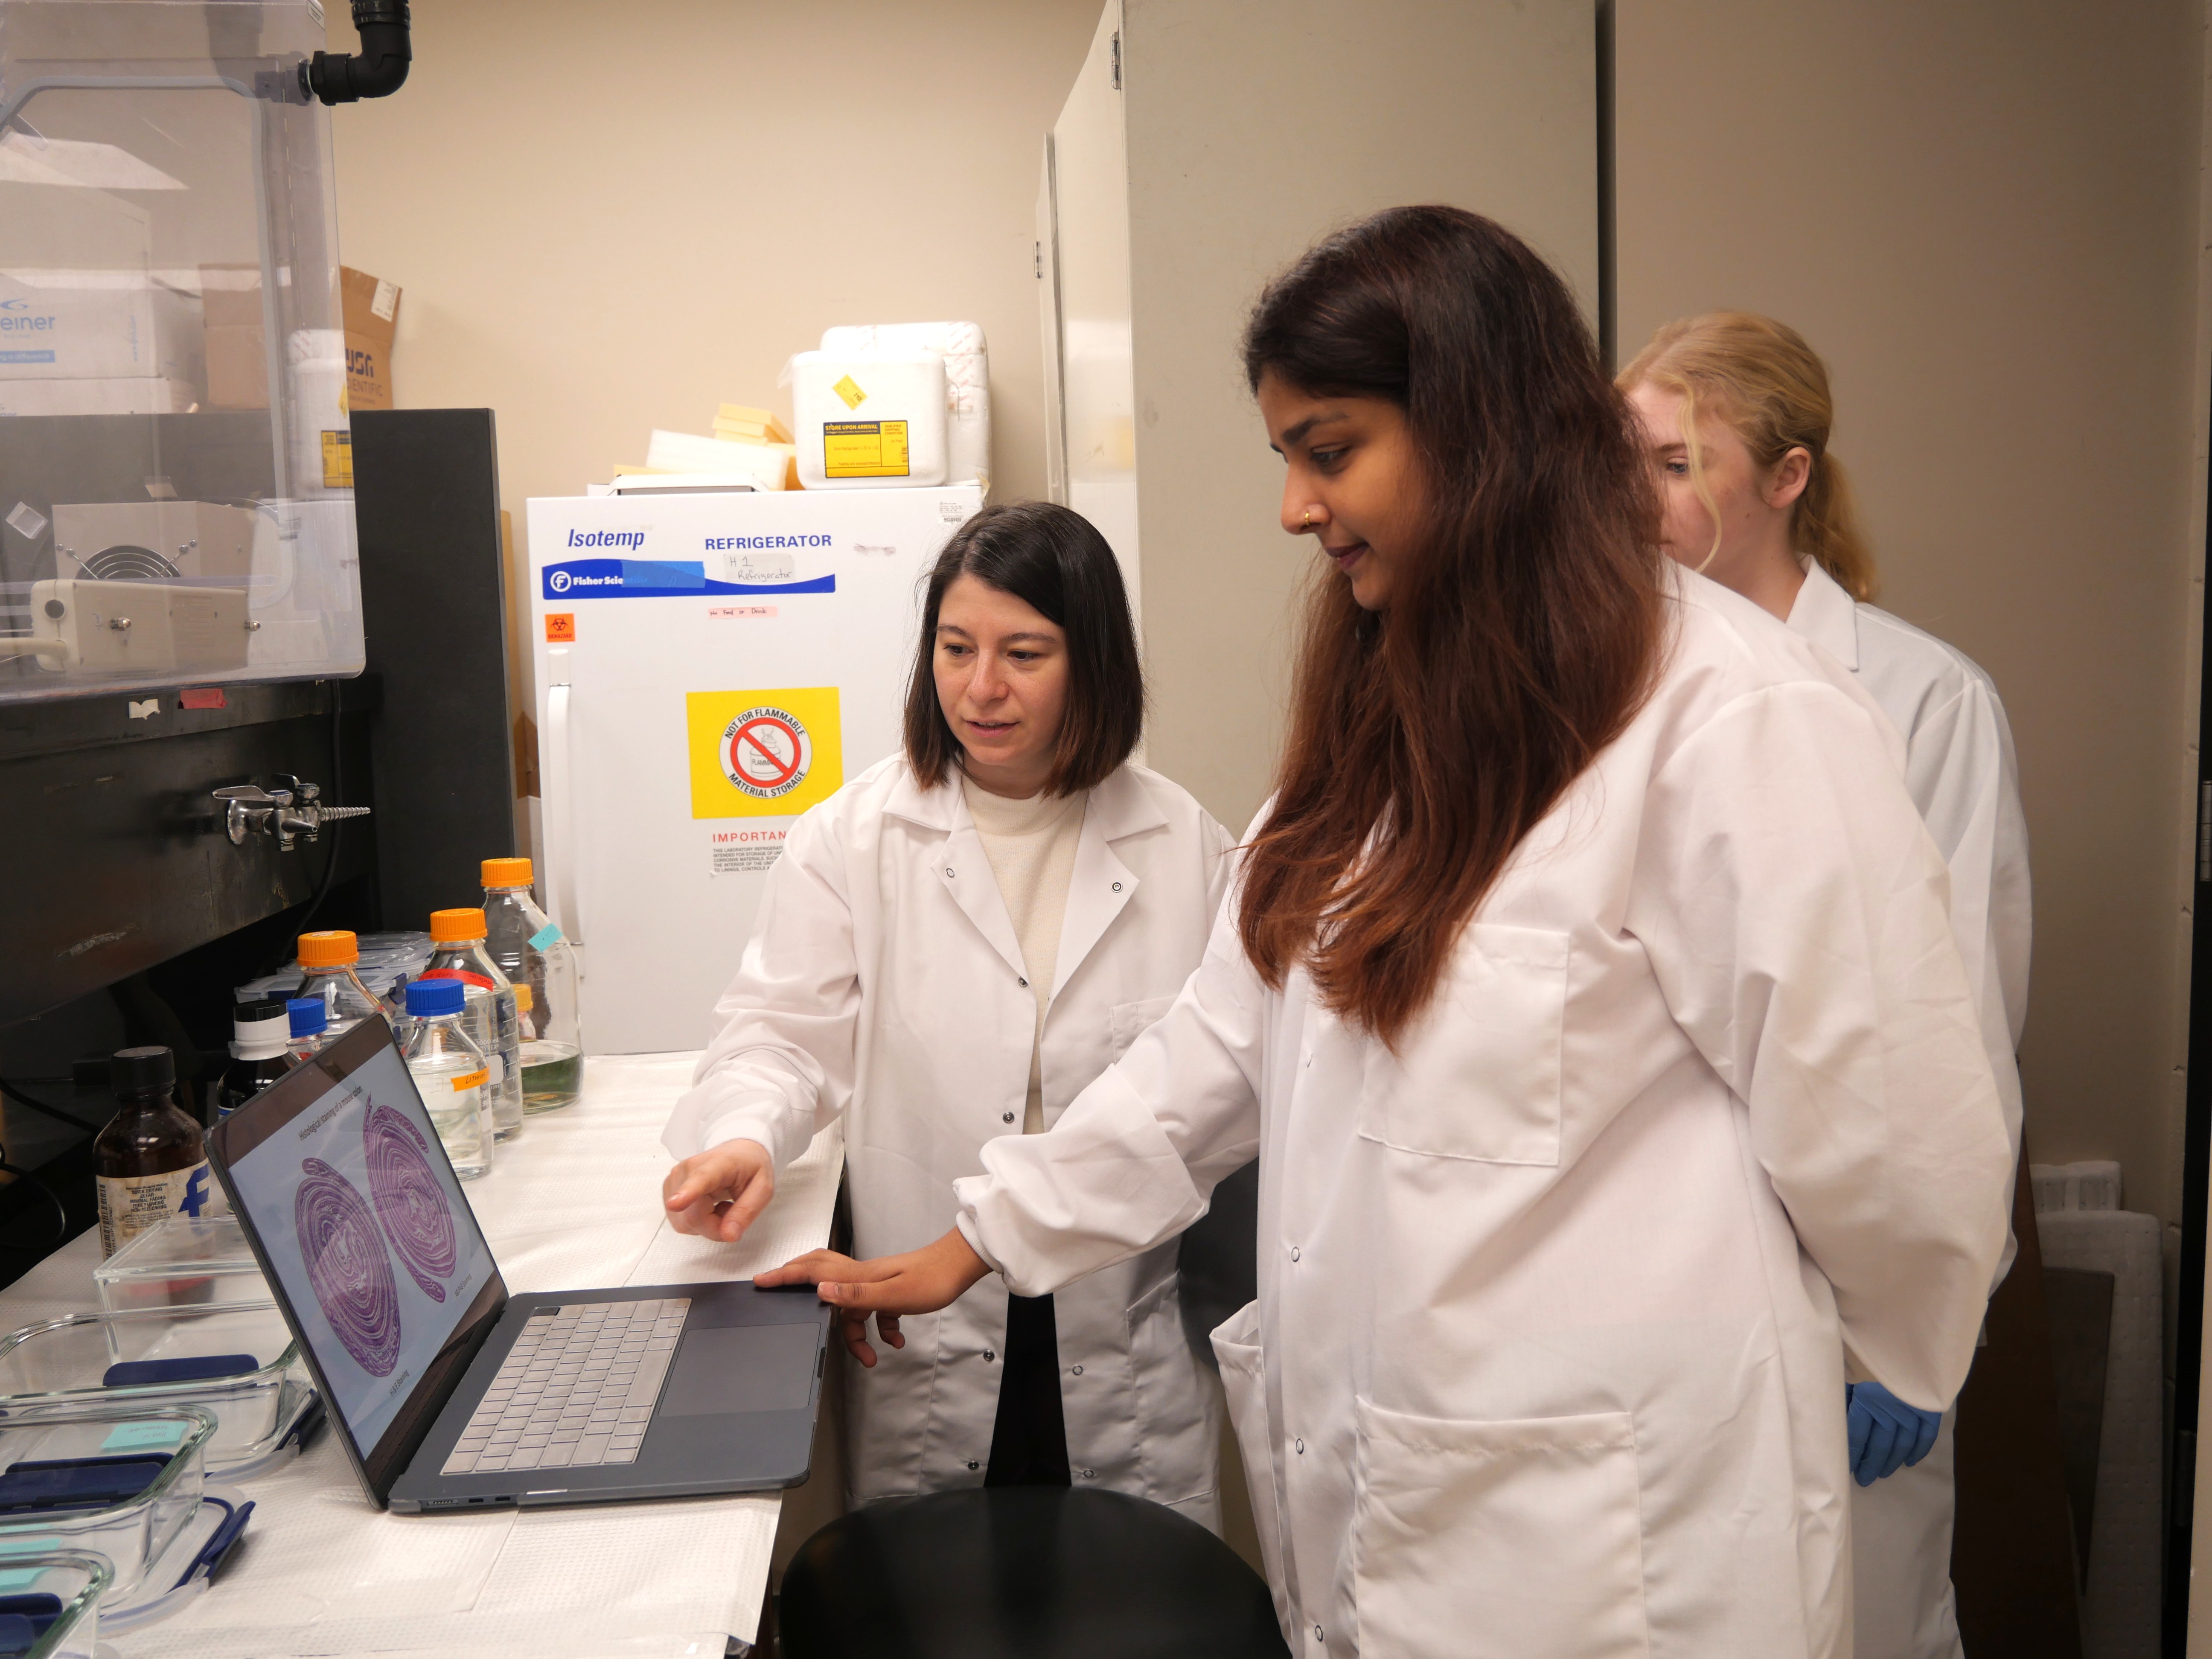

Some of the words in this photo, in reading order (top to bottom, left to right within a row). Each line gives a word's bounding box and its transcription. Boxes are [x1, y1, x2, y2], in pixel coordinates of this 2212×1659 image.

[568, 529, 644, 550] Isotemp
[705, 535, 832, 550] REFRIGERATOR
[730, 556, 736, 567] H
[573, 576, 603, 585] Fisher
[725, 722, 738, 739] NOT
[738, 711, 754, 725] FOR
[755, 708, 805, 736] FLAMMABLE
[729, 773, 768, 797] MATERIAL
[771, 770, 805, 797] STORAGE
[713, 830, 787, 842] IMPORTAN
[466, 1071, 485, 1084] LITHIUM
[298, 1117, 322, 1141] Histological
[320, 1108, 336, 1123] staining
[335, 1102, 340, 1112] of
[341, 1093, 354, 1106] mouse
[352, 1086, 363, 1097] colon
[131, 1204, 167, 1212] NON-YELLOWING
[396, 1369, 409, 1387] Staining
